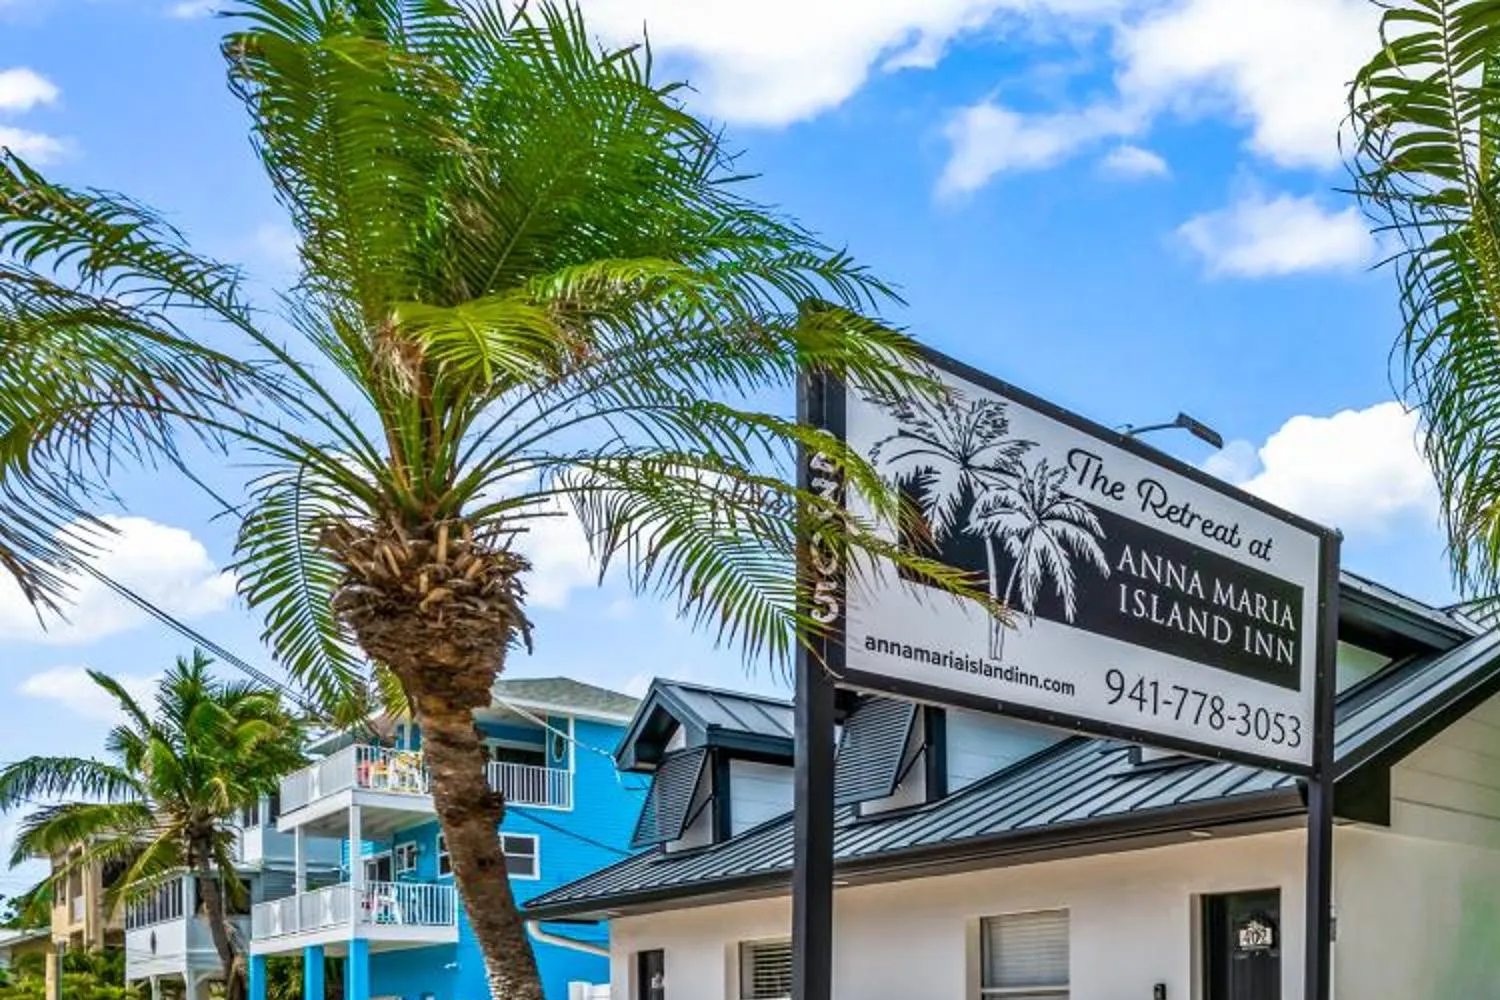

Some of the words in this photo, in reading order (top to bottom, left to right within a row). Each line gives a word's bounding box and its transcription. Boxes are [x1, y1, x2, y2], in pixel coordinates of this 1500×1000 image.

[1067, 447, 1125, 500] The
[1137, 477, 1242, 549] Retreat
[1248, 537, 1273, 562] at
[1117, 544, 1205, 600] ANNA
[1213, 577, 1297, 632] MARIA
[1119, 583, 1233, 645] ISLAND
[1244, 625, 1296, 666] INN
[865, 635, 1076, 697] annamariaislandinn.com
[1105, 668, 1301, 748] 941-778-3053
